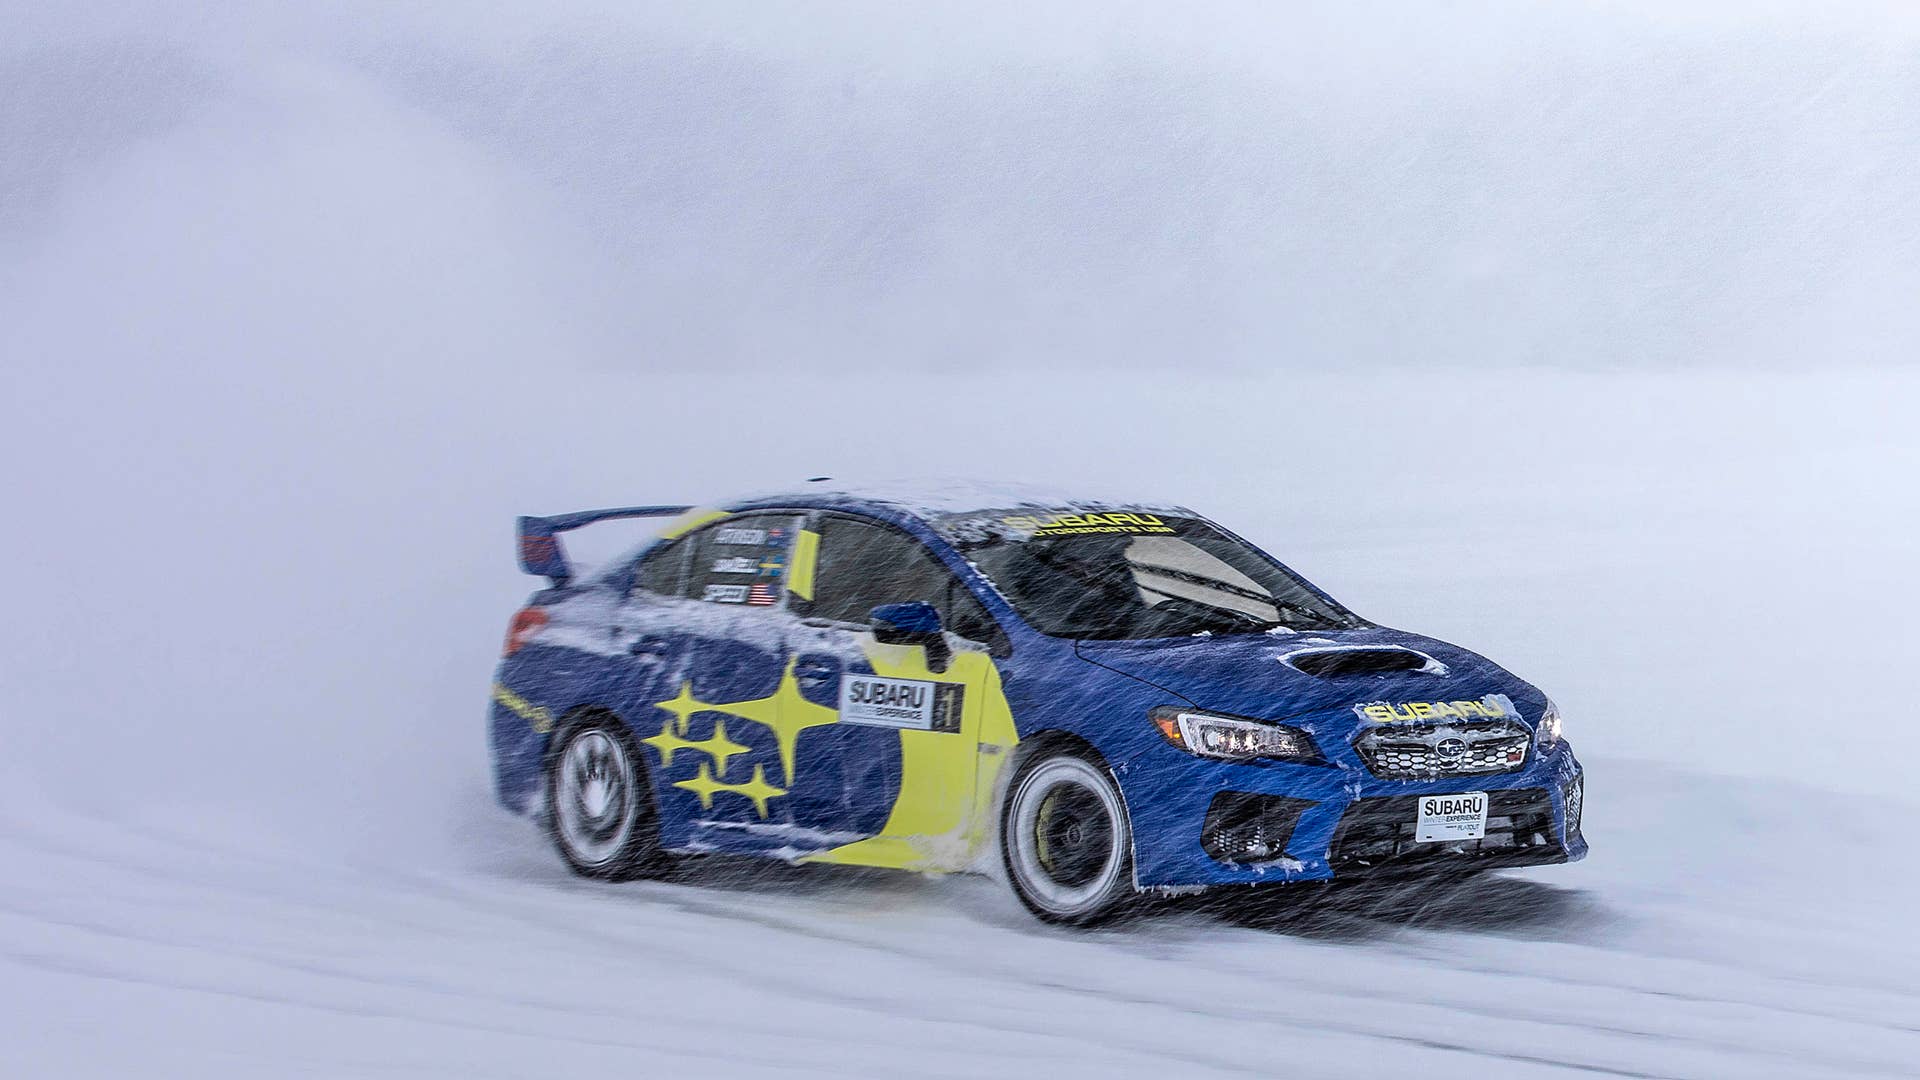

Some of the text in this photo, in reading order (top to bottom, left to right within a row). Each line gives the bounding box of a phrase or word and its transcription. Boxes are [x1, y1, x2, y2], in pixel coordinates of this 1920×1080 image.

[1002, 513, 1163, 528] SUBARU
[1032, 526, 1176, 537] OTORSPORTS USA
[849, 681, 925, 708] SUBARU
[1364, 700, 1505, 722] SUBARU
[1425, 798, 1482, 816] SUBARU
[1446, 814, 1481, 822] EXPERIENCE
